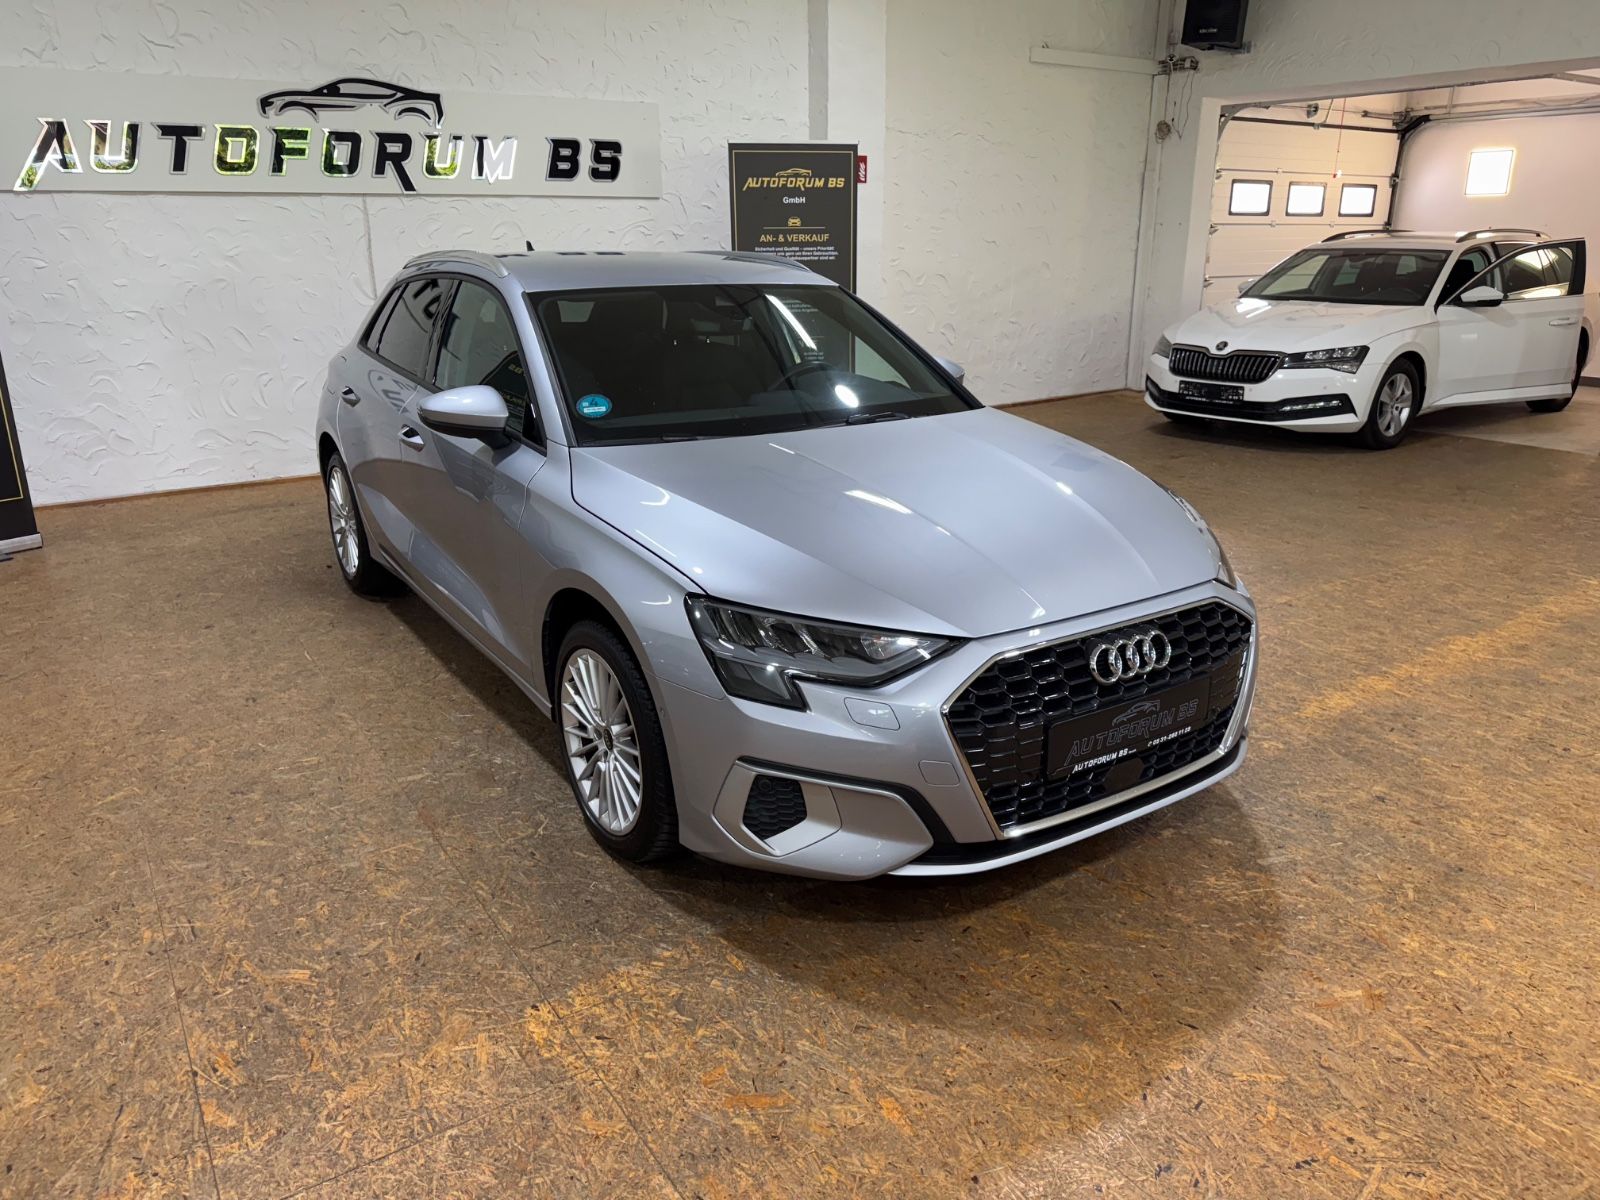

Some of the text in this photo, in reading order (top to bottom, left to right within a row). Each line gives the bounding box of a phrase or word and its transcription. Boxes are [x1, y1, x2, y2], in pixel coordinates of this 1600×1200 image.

[13, 117, 623, 194] AUTOFORUM BS
[742, 177, 845, 191] AUTOFORUM BS
[782, 196, 806, 204] GmbH
[760, 233, 830, 242] AN- & VERKAUF
[1063, 699, 1200, 767] AUTOFORUM BS
[1072, 747, 1129, 774] AUTOFORUM BS
